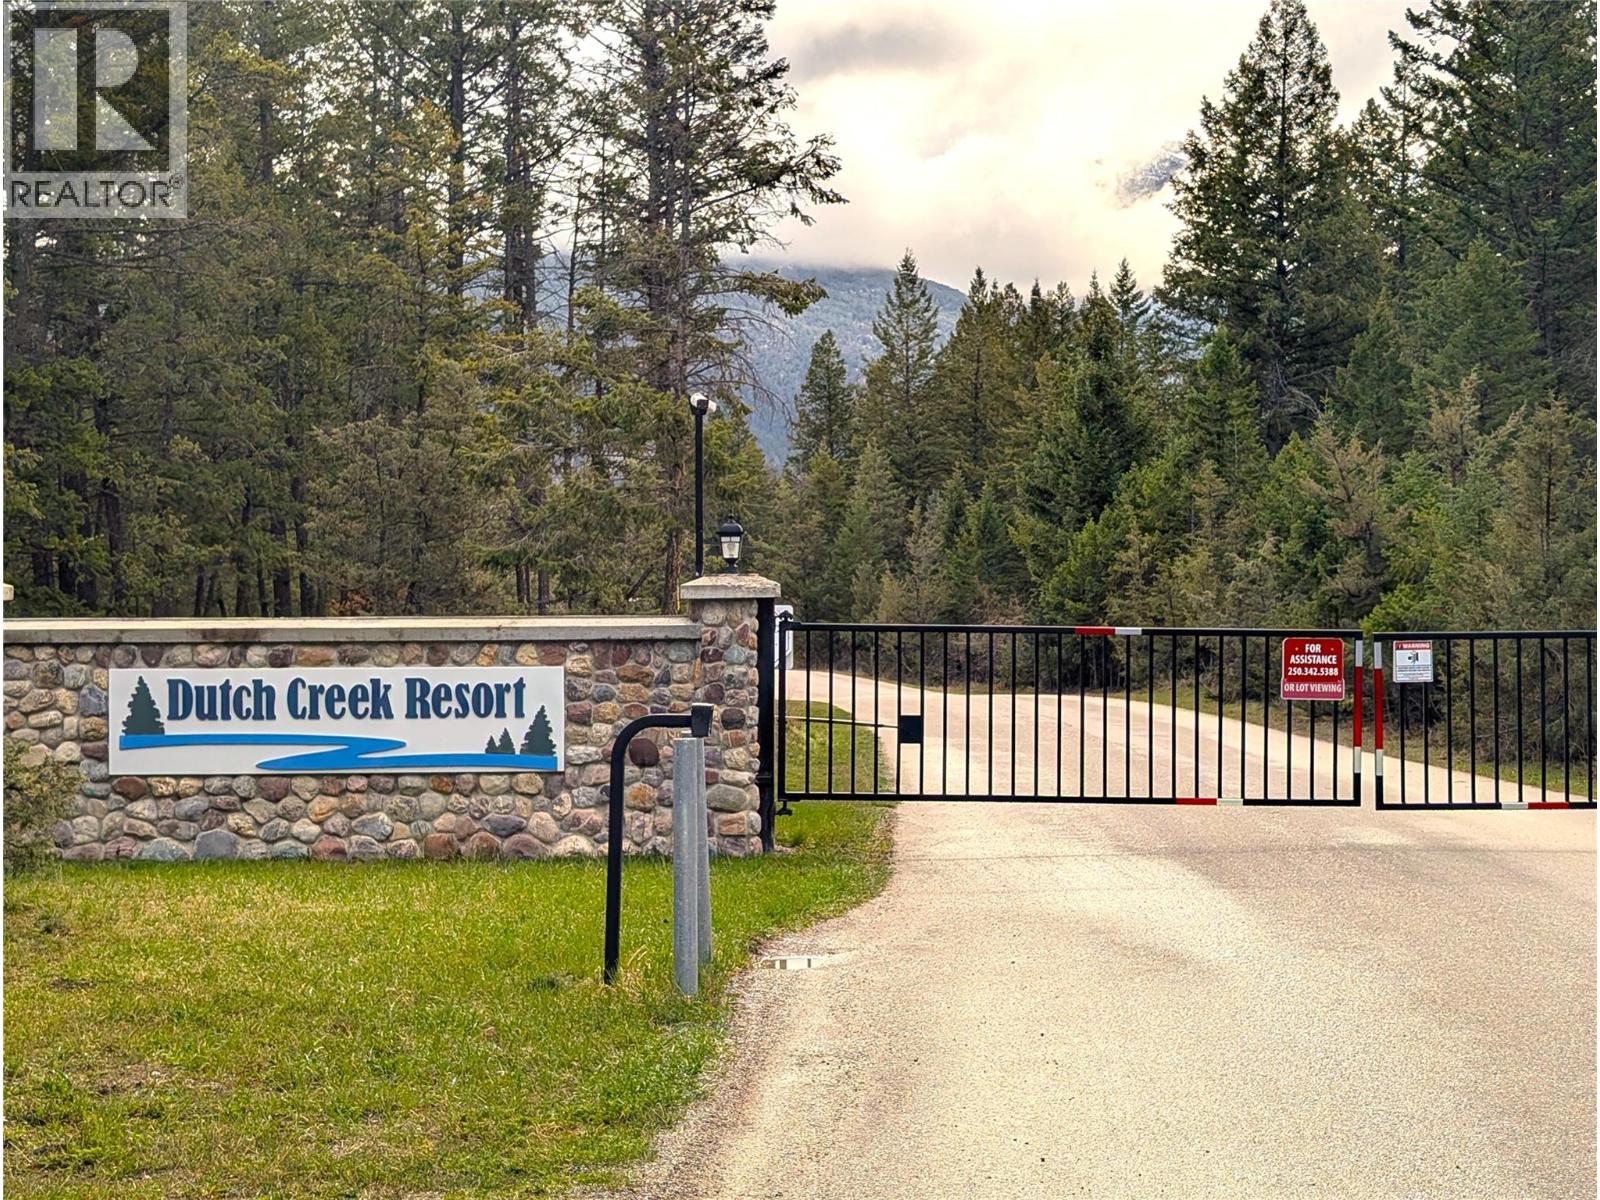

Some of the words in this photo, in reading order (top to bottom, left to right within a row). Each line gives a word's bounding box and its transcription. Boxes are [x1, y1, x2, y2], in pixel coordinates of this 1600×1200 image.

[1305, 643, 1321, 653] FOR
[1402, 642, 1430, 650] WARNING
[1289, 654, 1337, 665] ASSISTANCE
[1287, 667, 1339, 676] 250.342.5388
[1284, 683, 1296, 693] OR
[1296, 683, 1309, 693] LOT
[1310, 683, 1342, 693] VIEWING
[166, 678, 276, 721] Dutch
[286, 677, 395, 720] Creek
[404, 677, 526, 720] Resort
